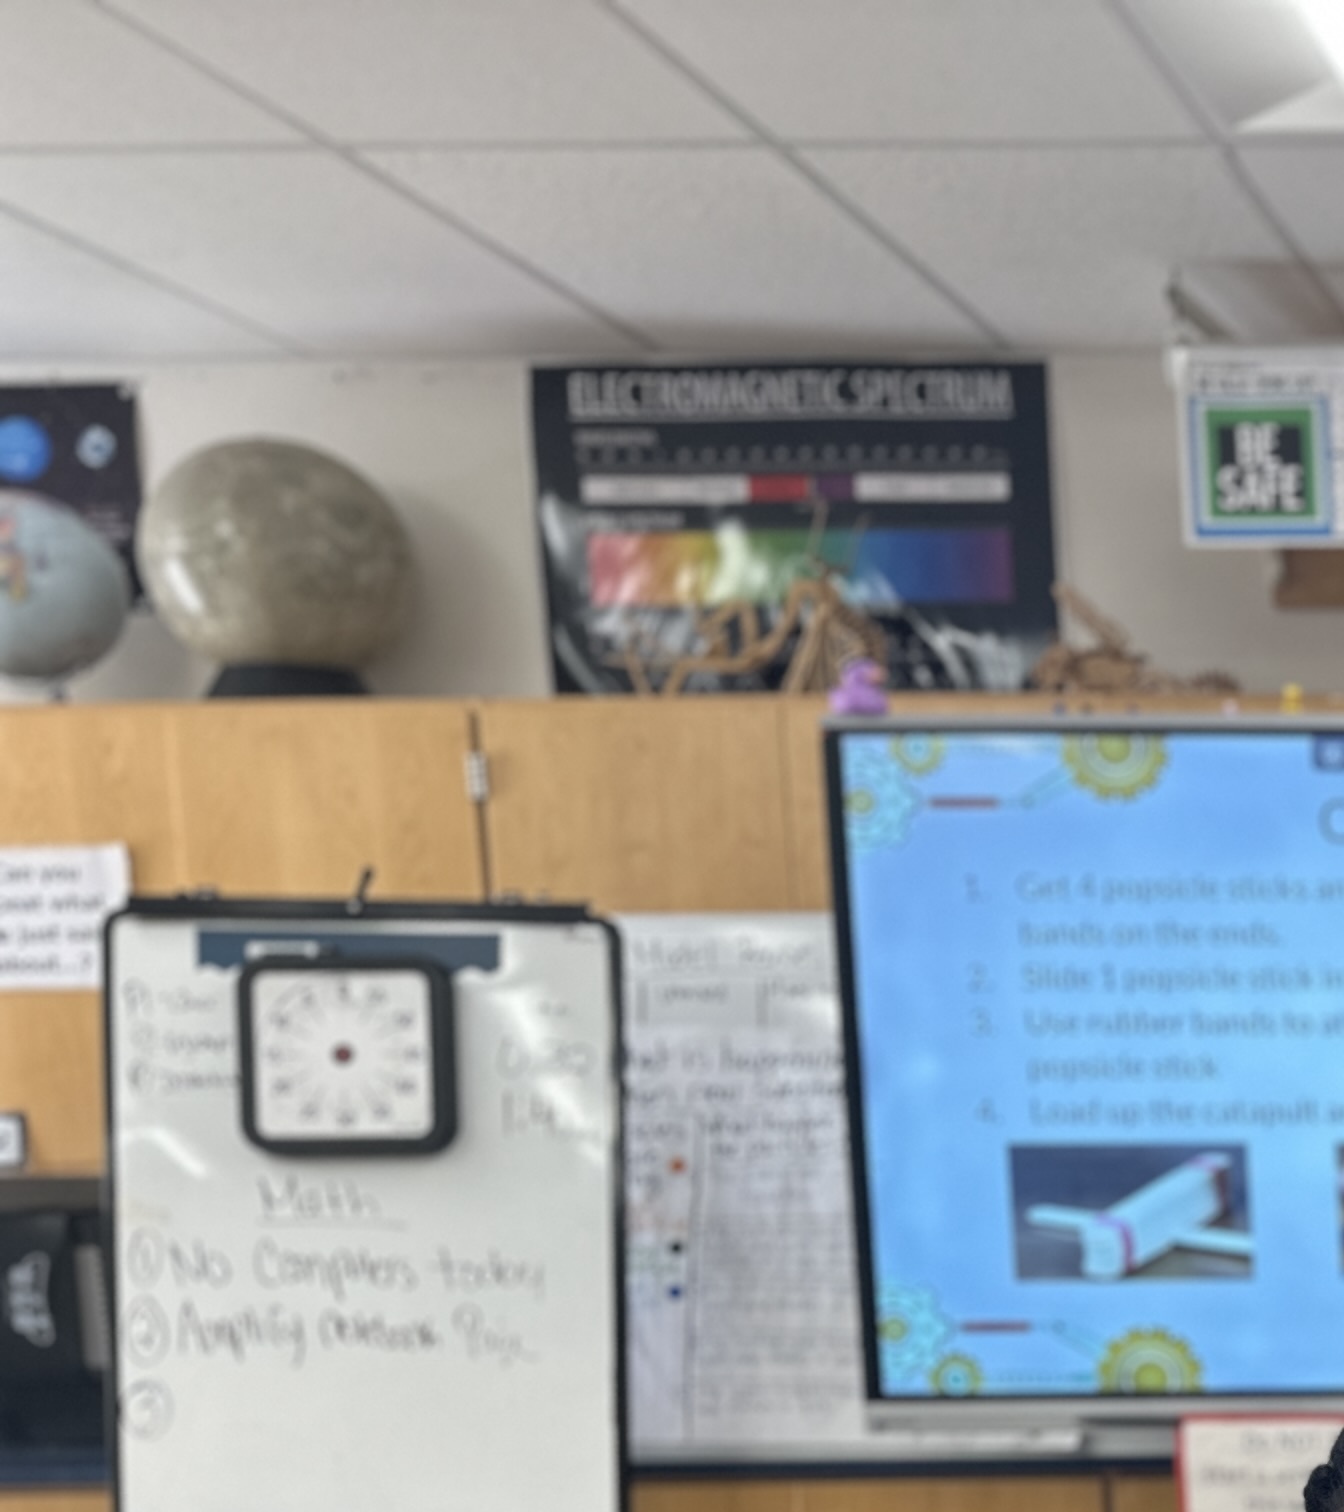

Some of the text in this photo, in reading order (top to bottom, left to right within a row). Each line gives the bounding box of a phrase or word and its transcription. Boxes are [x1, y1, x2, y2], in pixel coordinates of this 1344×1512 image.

[1234, 421, 1281, 467] BE
[1214, 464, 1305, 514] SAFE
[1013, 870, 1069, 903] Get
[1074, 870, 1097, 903] 4
[1100, 870, 1219, 903] popsicle
[1227, 870, 1309, 903] sticks
[1018, 920, 1106, 948] bands
[1110, 920, 1150, 948] on
[1155, 920, 1201, 948] the
[1020, 960, 1095, 994] Slide
[1122, 960, 1241, 994] popsicle
[1023, 1006, 1080, 1040] Use
[1086, 1006, 1186, 1040] rubber
[1191, 1006, 1277, 1040] bands
[1024, 1055, 1146, 1085] popsicle
[1027, 1099, 1100, 1127] Load
[1149, 1099, 1196, 1127] the
[1201, 1099, 1320, 1127] catapult
[255, 1173, 384, 1221] Math
[167, 1238, 234, 1291] No
[428, 1245, 549, 1302] today
